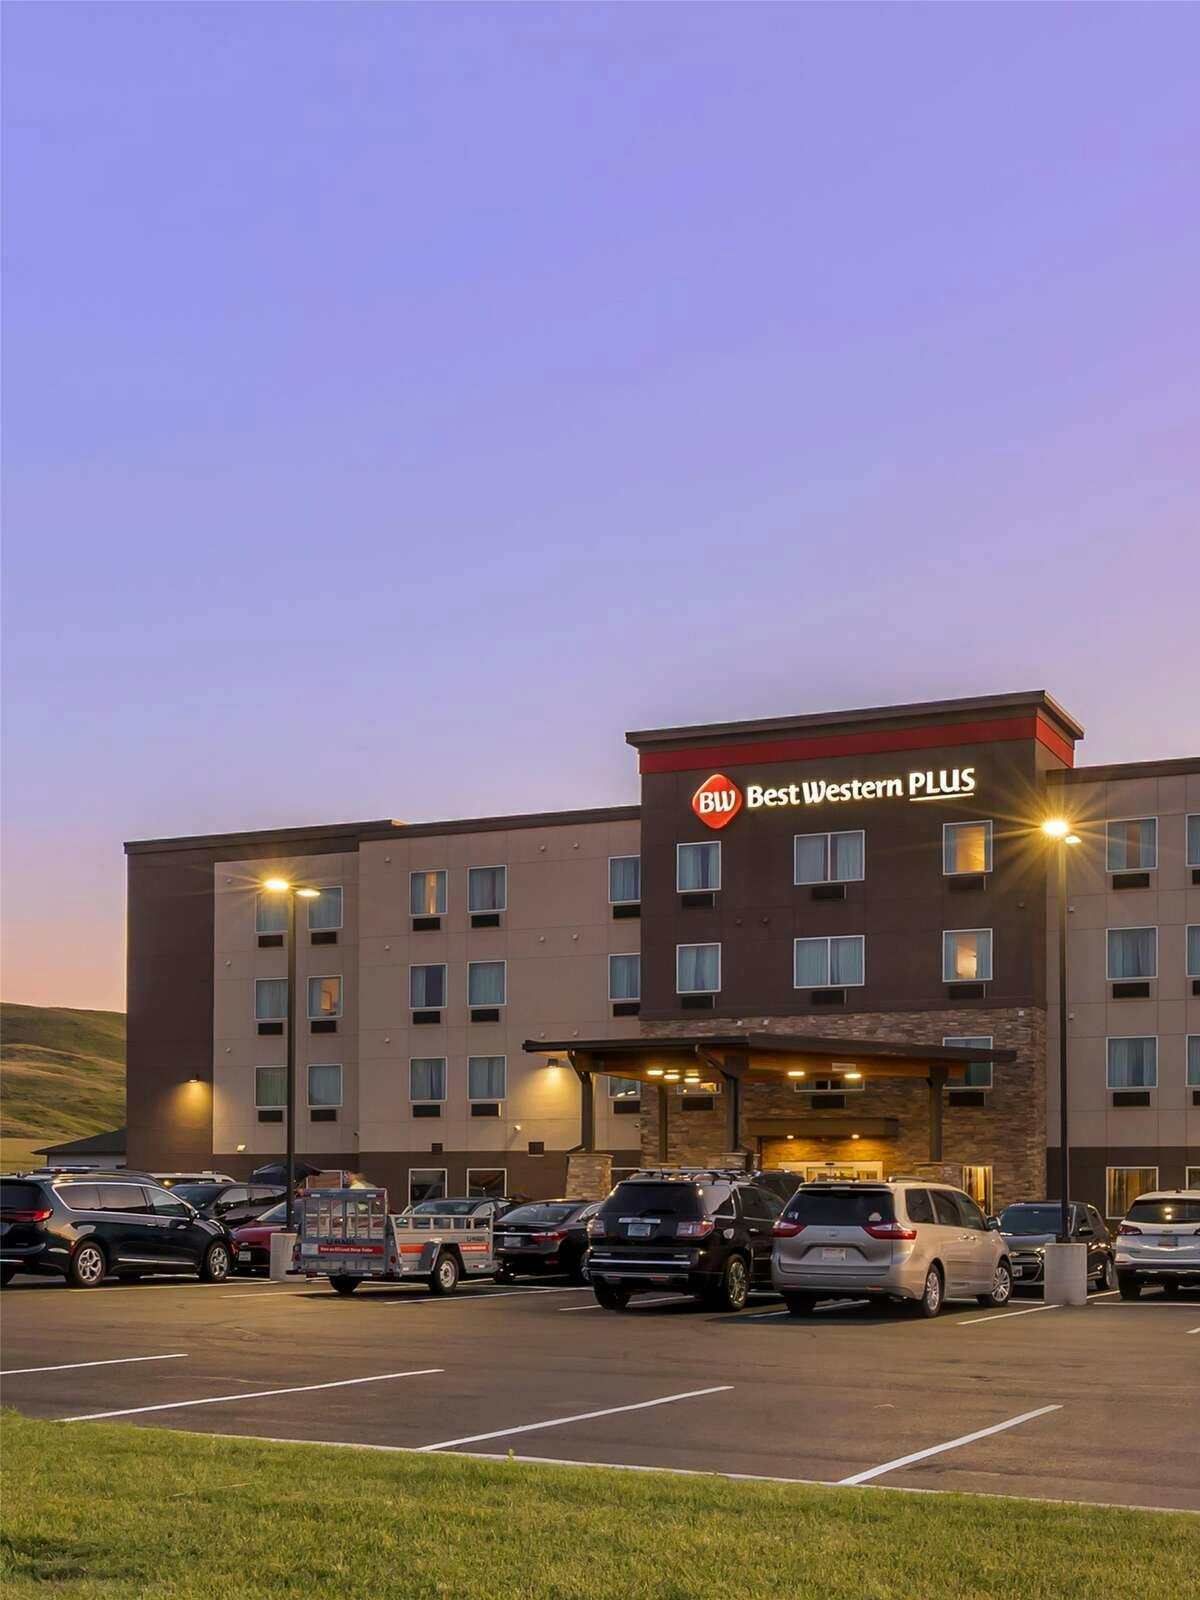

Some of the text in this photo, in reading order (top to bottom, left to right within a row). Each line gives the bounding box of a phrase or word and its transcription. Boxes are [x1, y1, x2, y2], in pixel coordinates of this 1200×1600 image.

[700, 790, 736, 814] BW
[746, 767, 976, 808] Best Western PLUS
